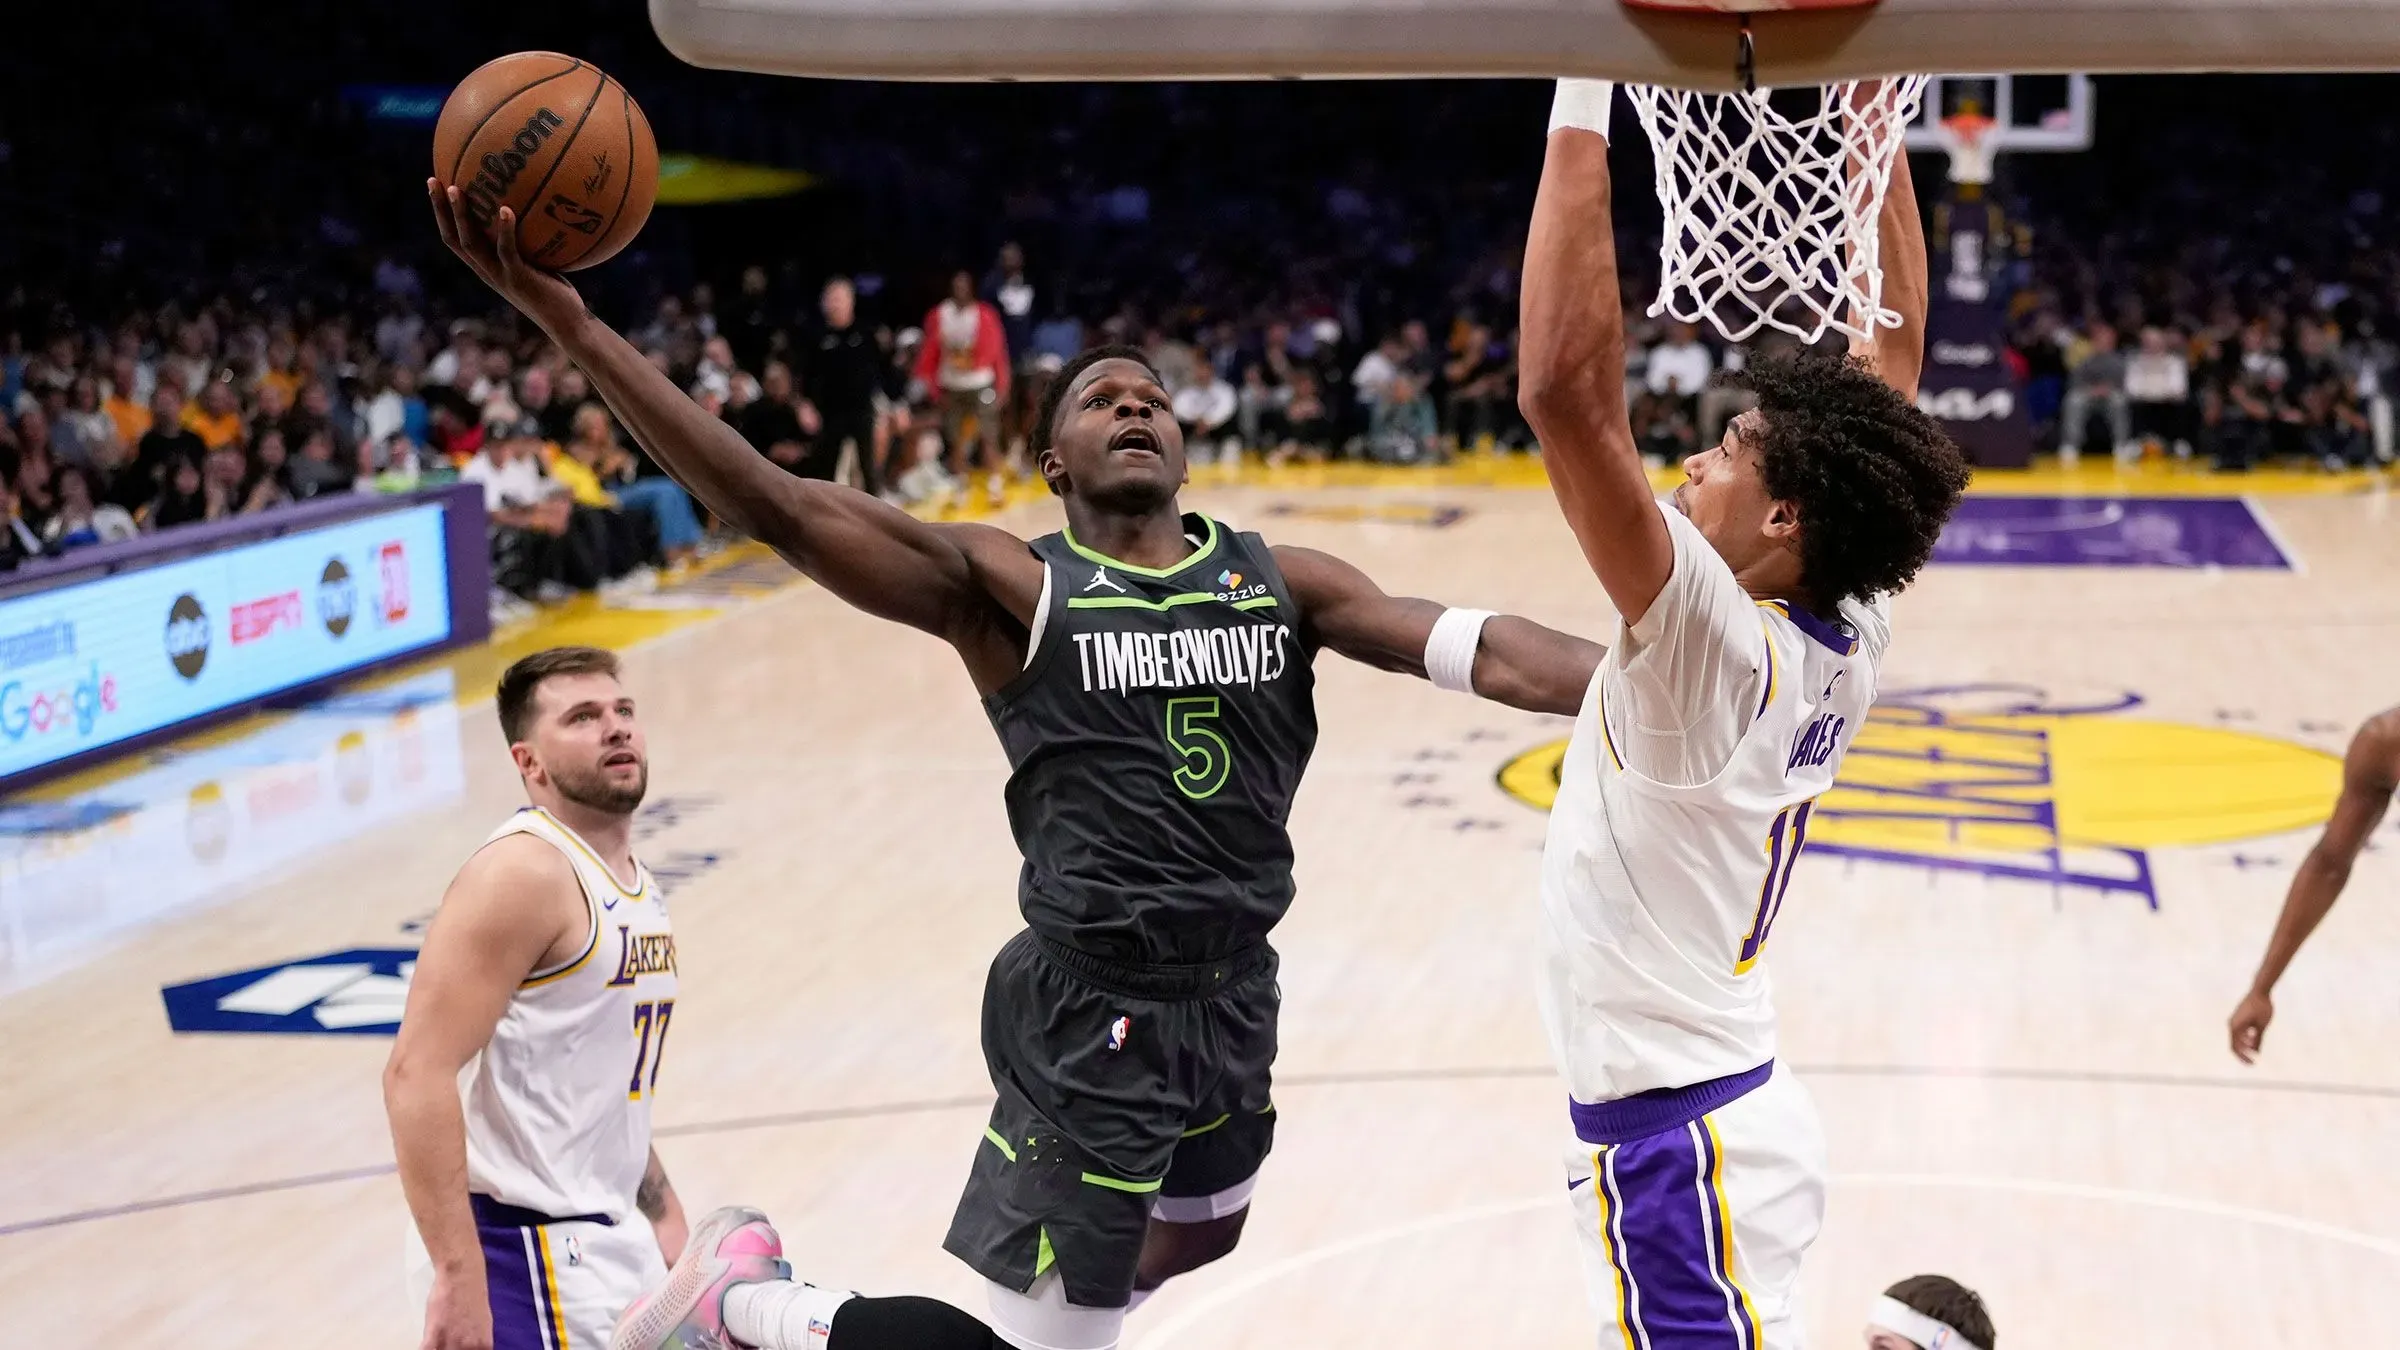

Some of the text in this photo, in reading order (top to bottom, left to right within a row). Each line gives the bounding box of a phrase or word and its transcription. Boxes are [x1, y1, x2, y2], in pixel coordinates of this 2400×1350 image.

[466, 107, 564, 226] Wilson
[230, 589, 303, 646] ESPN
[1208, 583, 1267, 602] ezzle
[0, 658, 118, 740] Google
[1072, 624, 1290, 698] TIMBERWOLVES
[1166, 697, 1231, 799] 5
[1733, 797, 1816, 976] 11
[605, 925, 678, 988] LAKER
[628, 998, 676, 1101] 77
